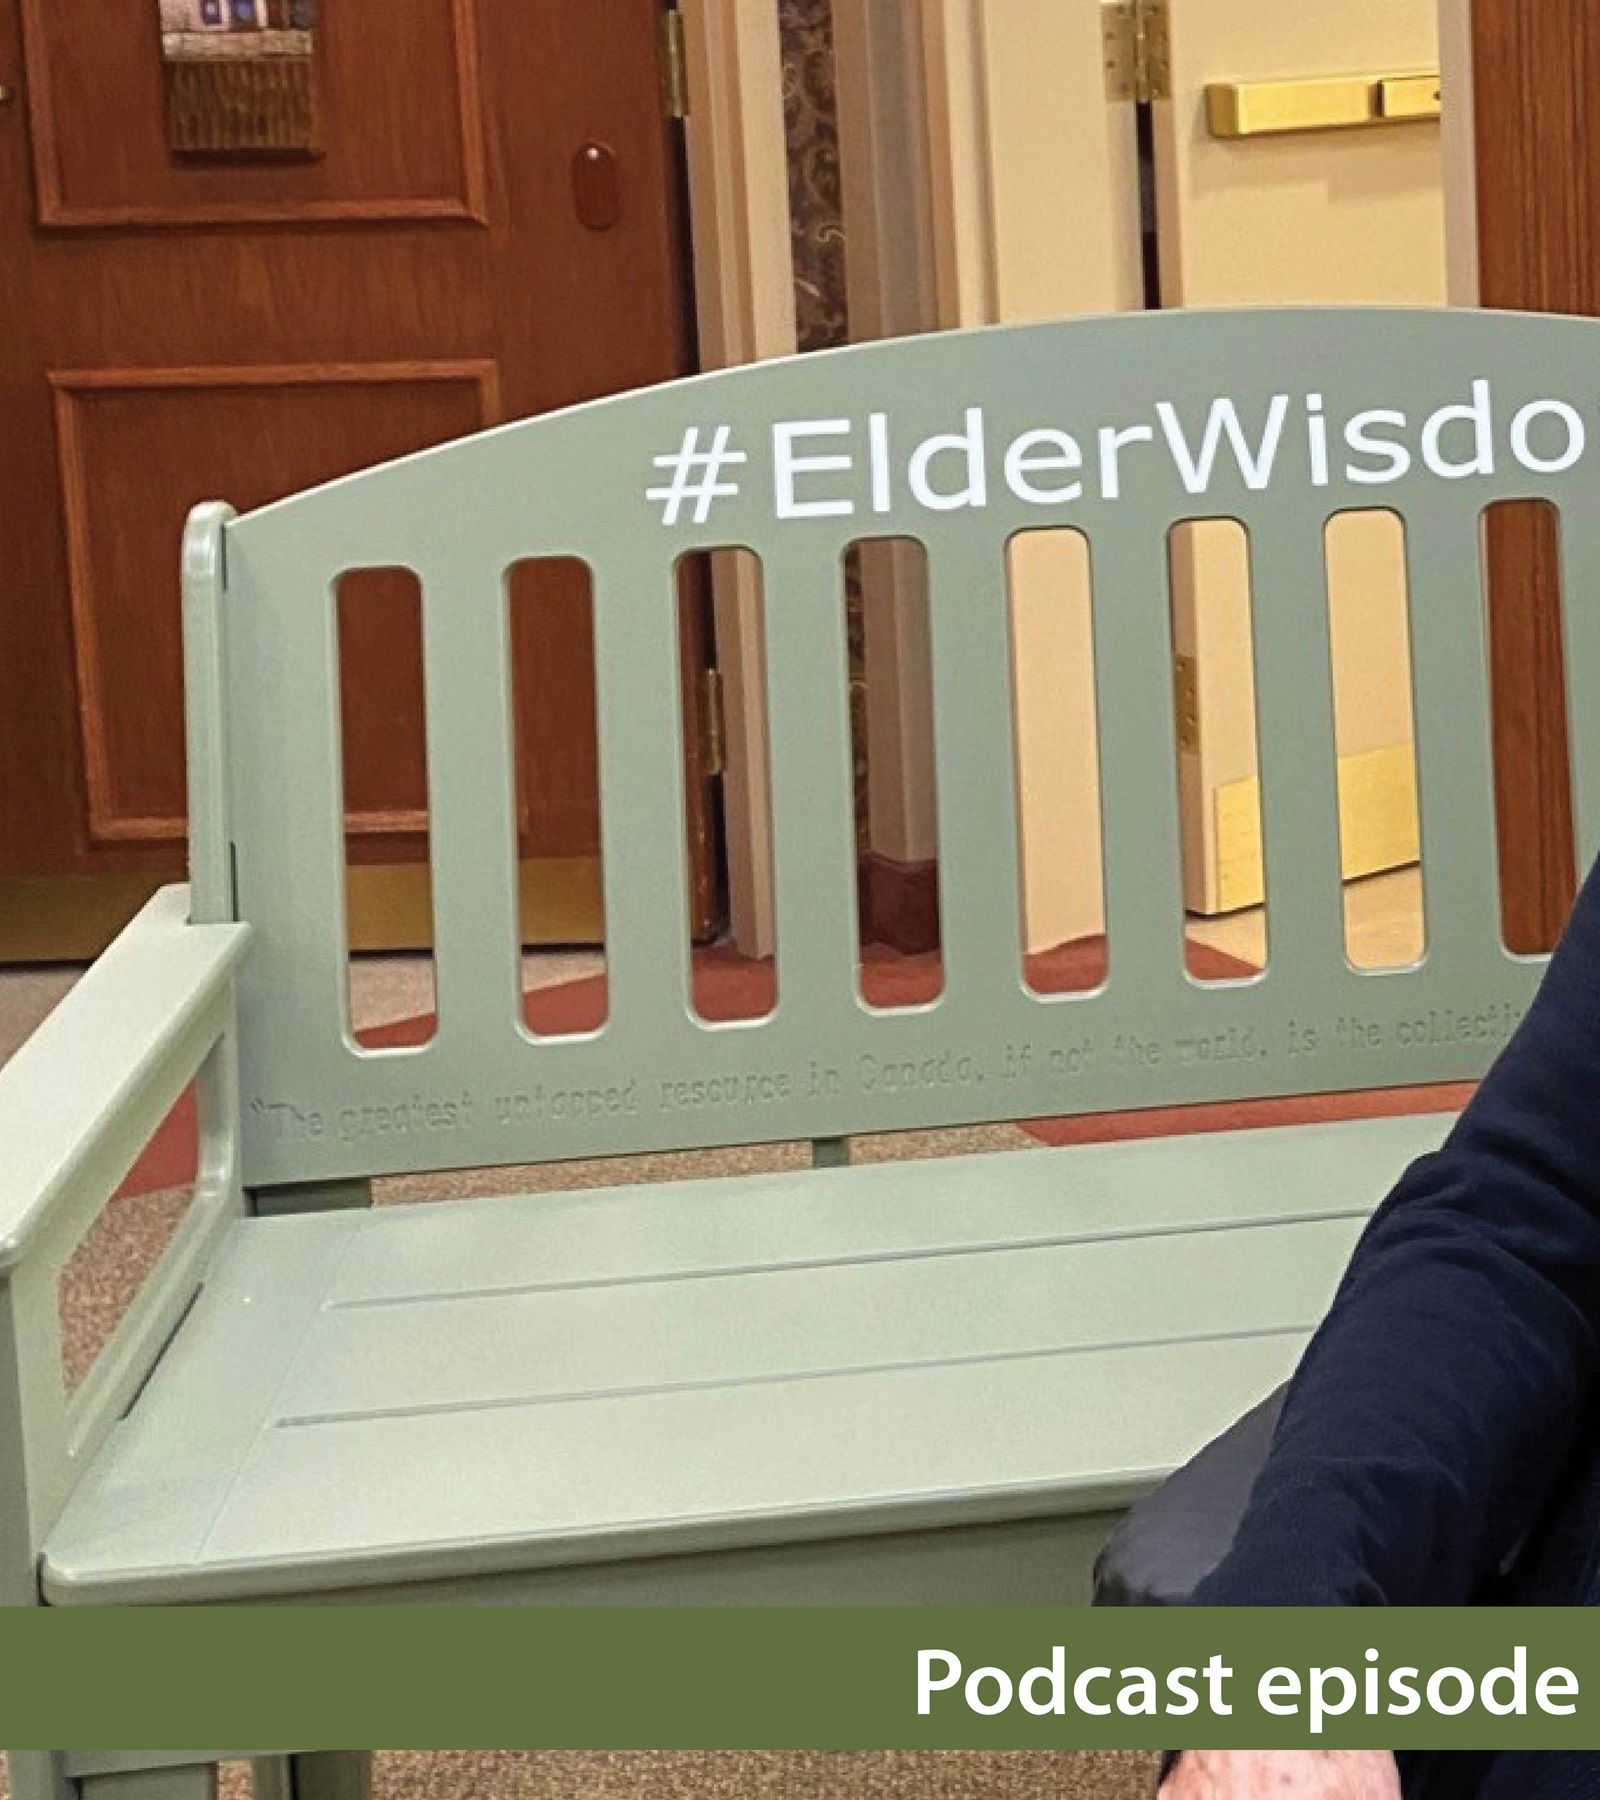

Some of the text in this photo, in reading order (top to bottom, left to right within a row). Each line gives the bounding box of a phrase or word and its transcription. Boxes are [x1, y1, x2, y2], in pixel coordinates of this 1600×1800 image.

[659, 1072, 793, 1112] resource
[806, 1058, 841, 1097] in
[1002, 1040, 1034, 1080] if
[1049, 1036, 1094, 1075] not
[1114, 1033, 1162, 1068] the
[1287, 1017, 1318, 1057] is
[1337, 1014, 1382, 1050] the
